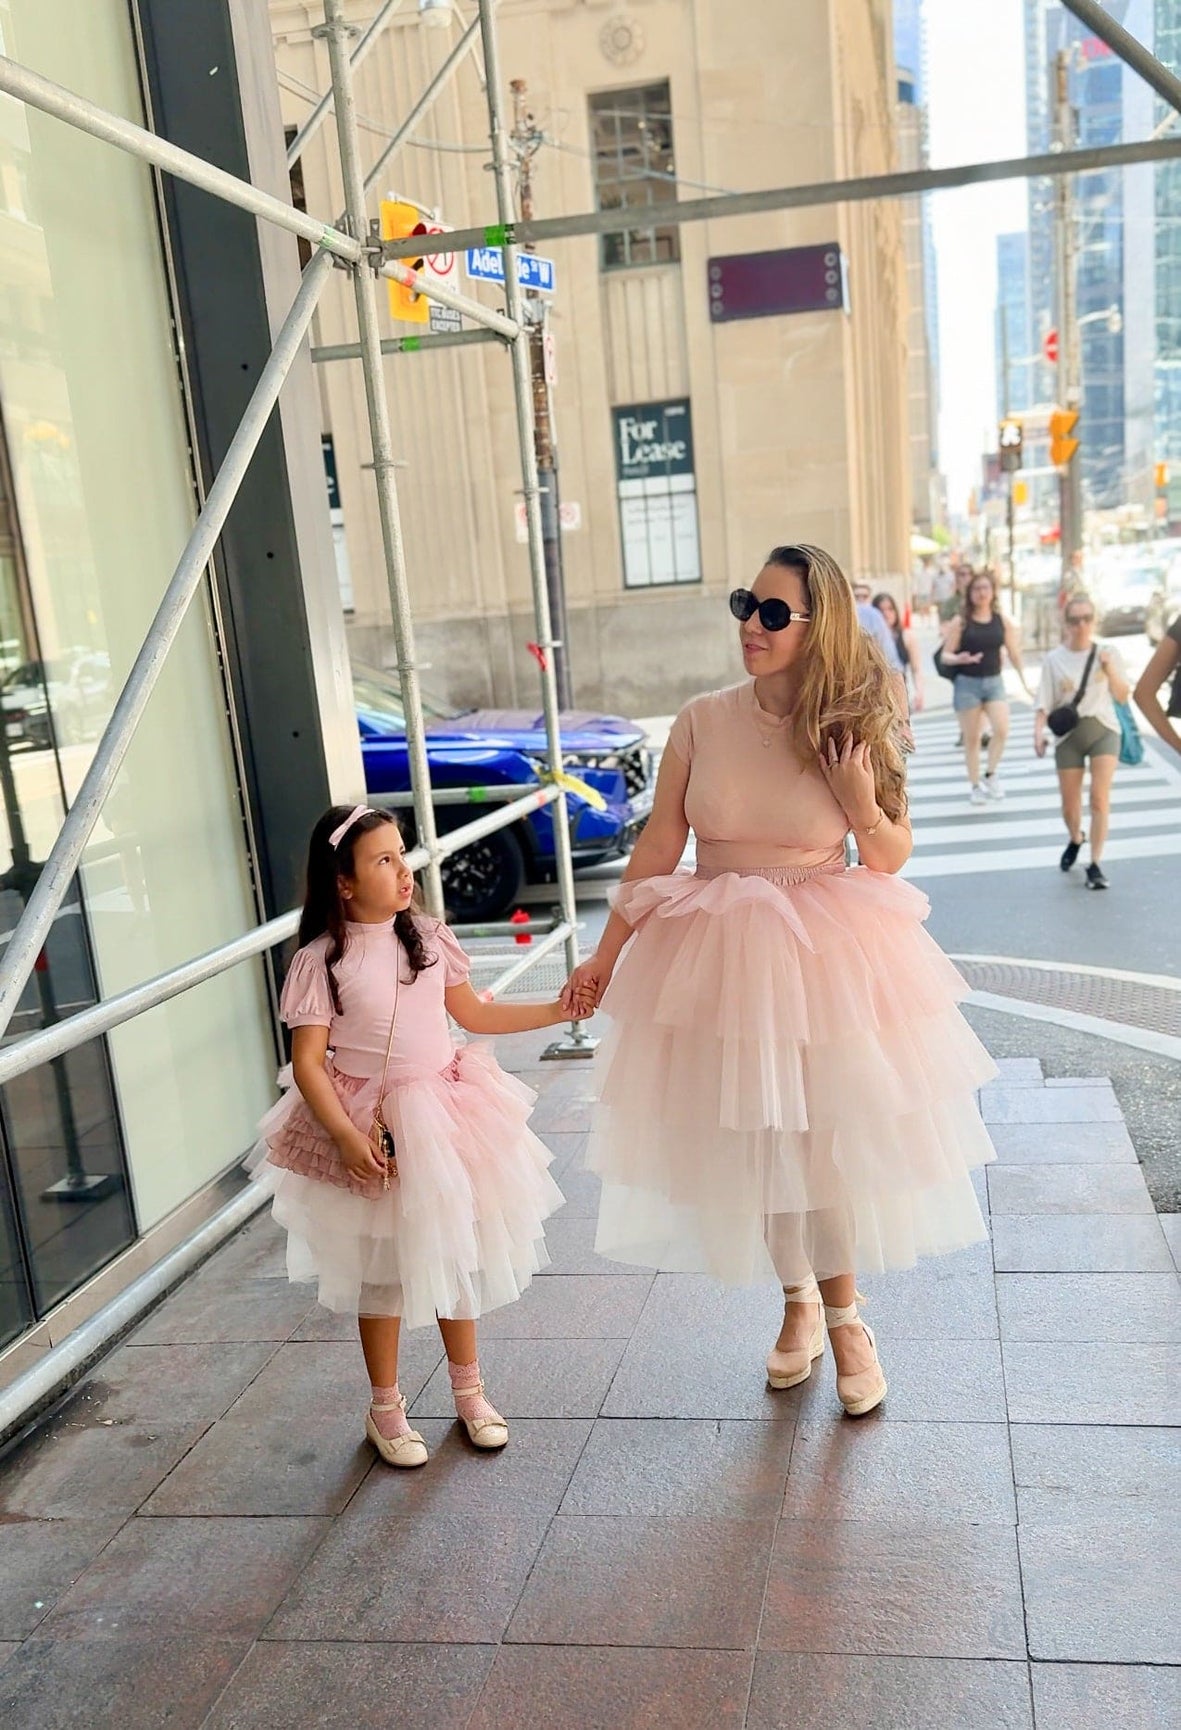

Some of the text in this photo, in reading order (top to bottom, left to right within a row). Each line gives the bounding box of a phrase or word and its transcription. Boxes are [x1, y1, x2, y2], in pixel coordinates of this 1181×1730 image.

[539, 261, 550, 284] W
[619, 416, 658, 441] For
[622, 440, 687, 465] Lease
